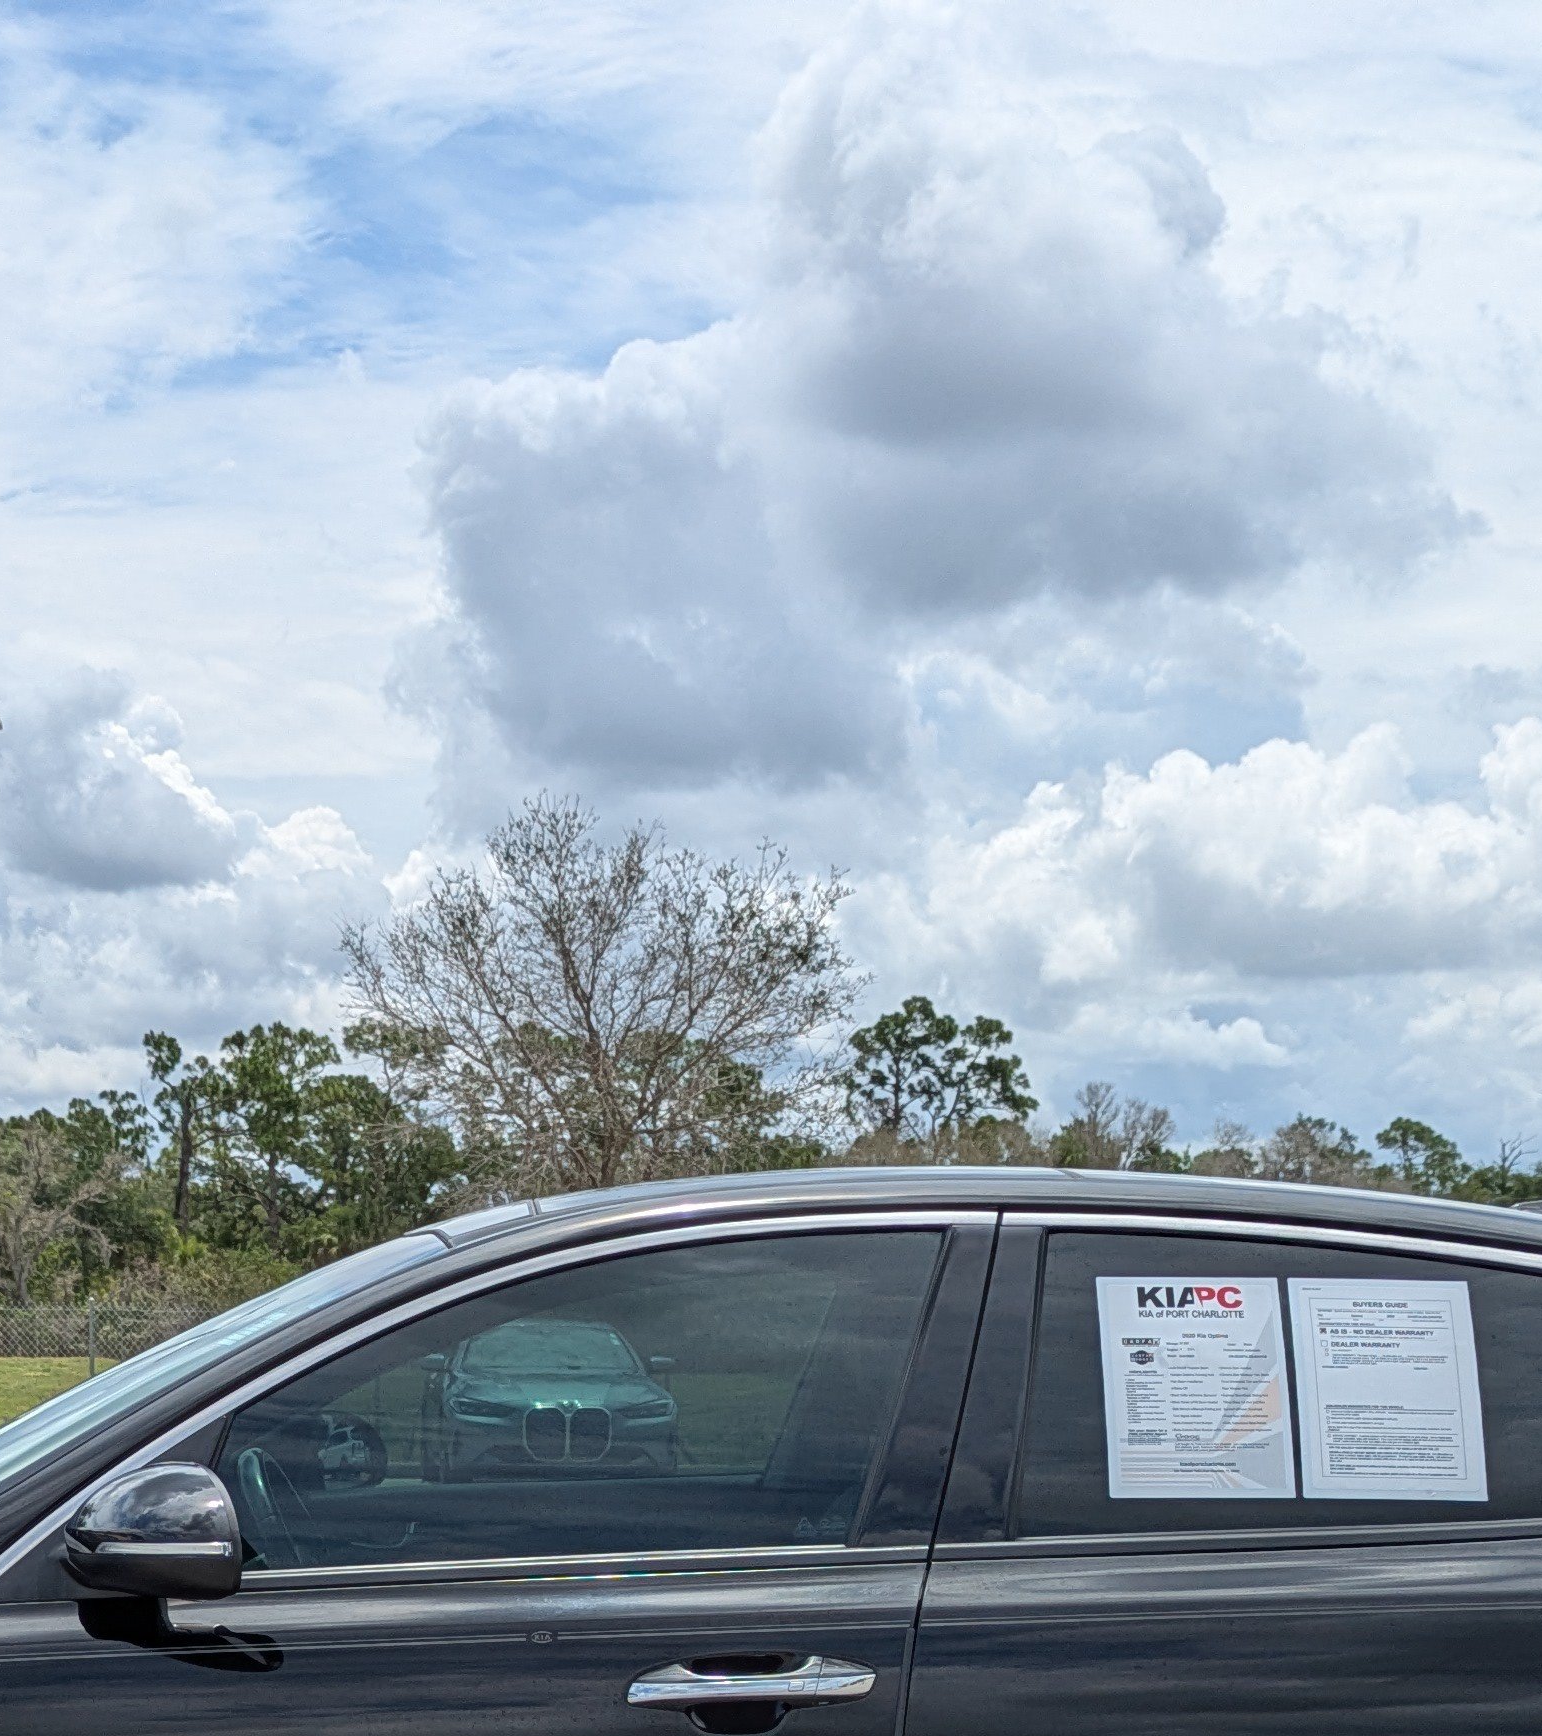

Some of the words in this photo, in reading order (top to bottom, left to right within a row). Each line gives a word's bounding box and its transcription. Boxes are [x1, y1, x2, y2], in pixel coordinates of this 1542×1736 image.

[1138, 1310, 1155, 1318] KIA
[1155, 1310, 1165, 1318] of
[1165, 1310, 1189, 1319] PORT
[1191, 1310, 1245, 1319] CHARLOTTE
